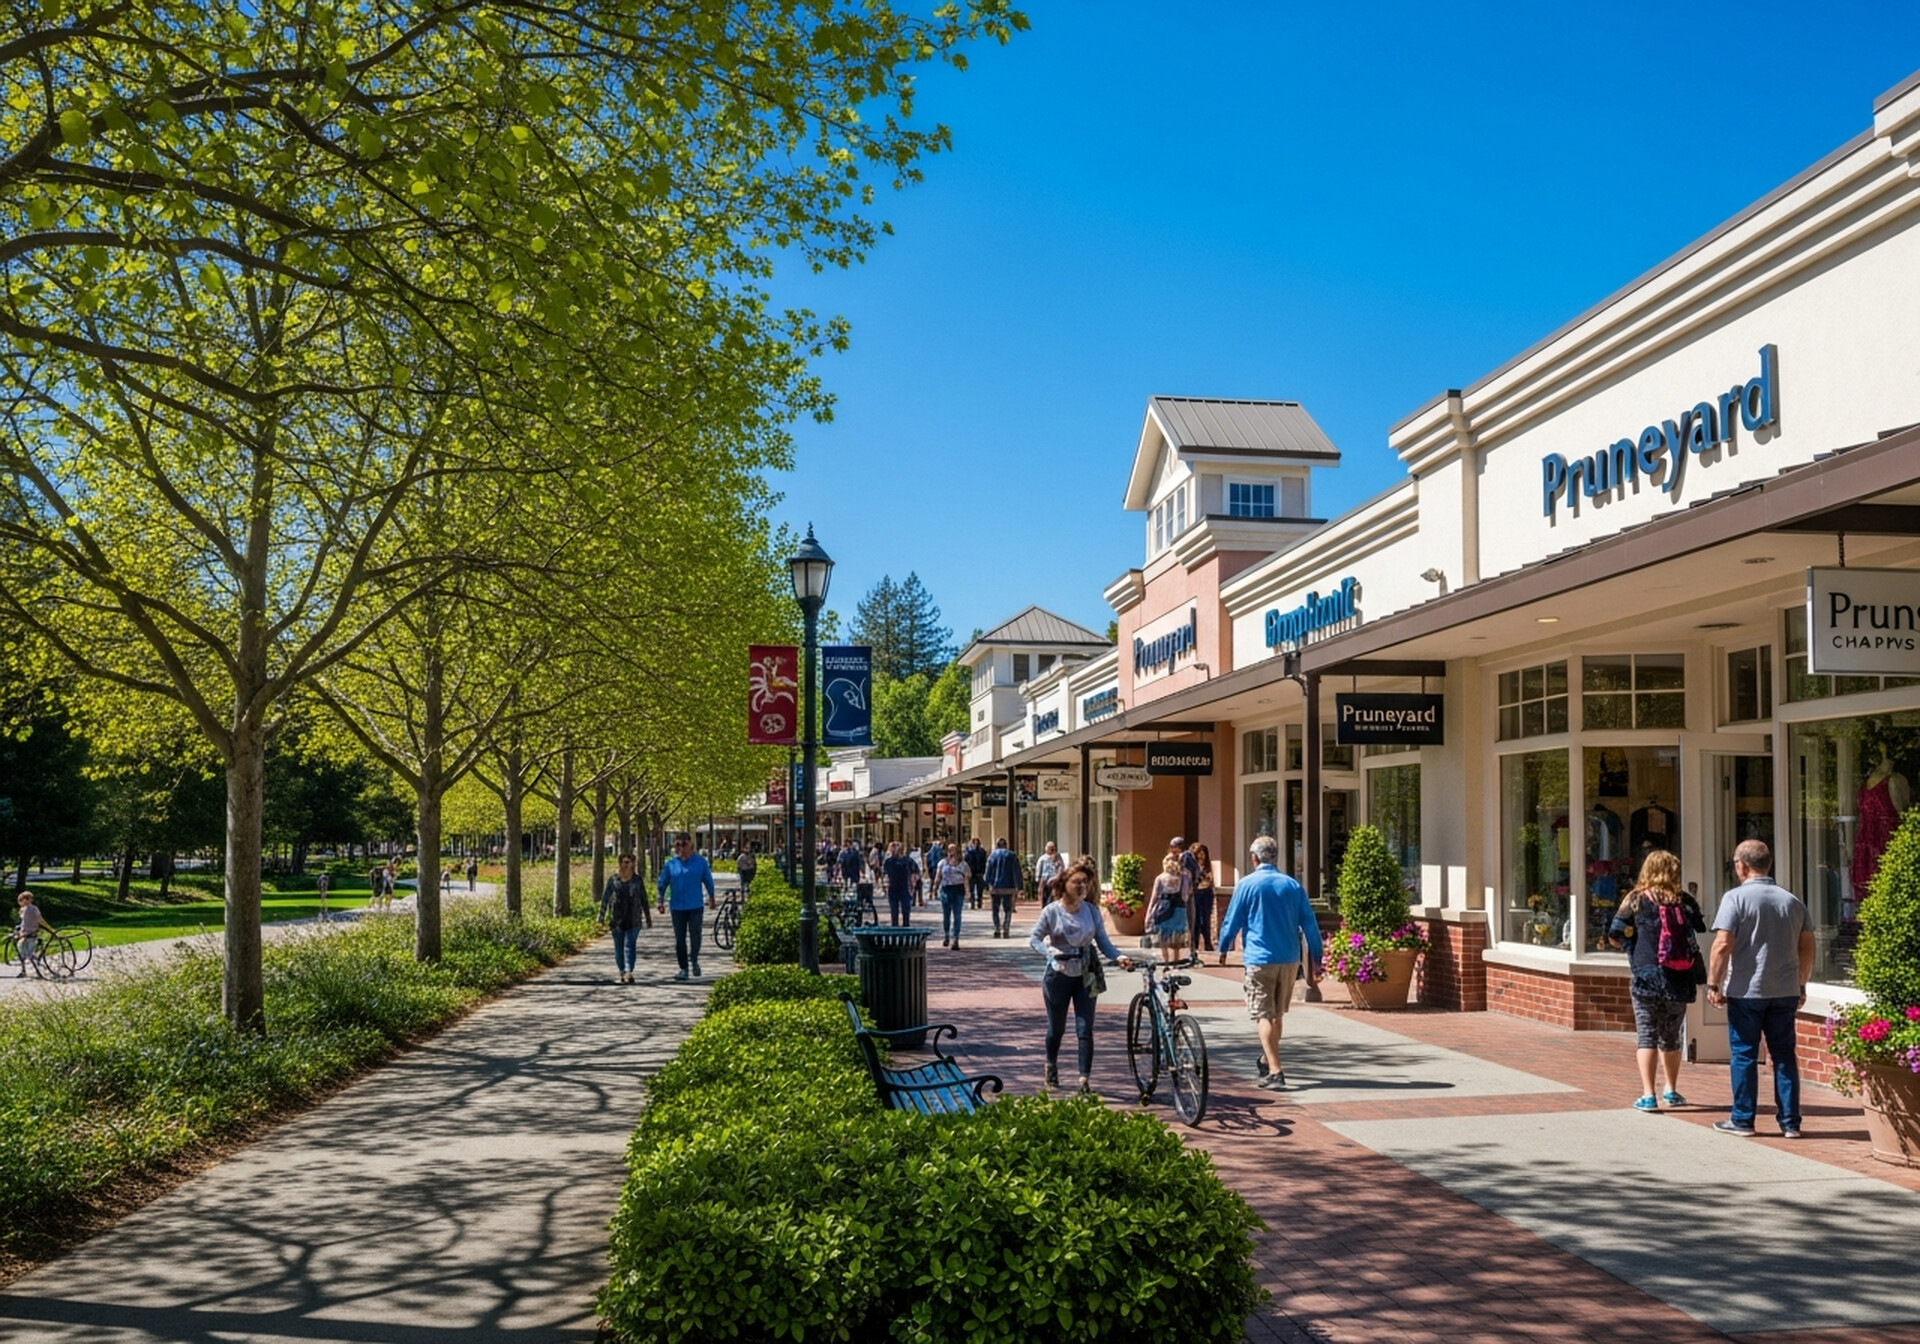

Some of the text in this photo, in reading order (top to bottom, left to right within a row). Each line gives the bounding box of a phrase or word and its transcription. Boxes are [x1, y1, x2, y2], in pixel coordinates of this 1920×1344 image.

[1542, 343, 1779, 517] Pruneyard
[1828, 592, 1920, 631] Prun
[1343, 704, 1436, 729] Pruneyard
